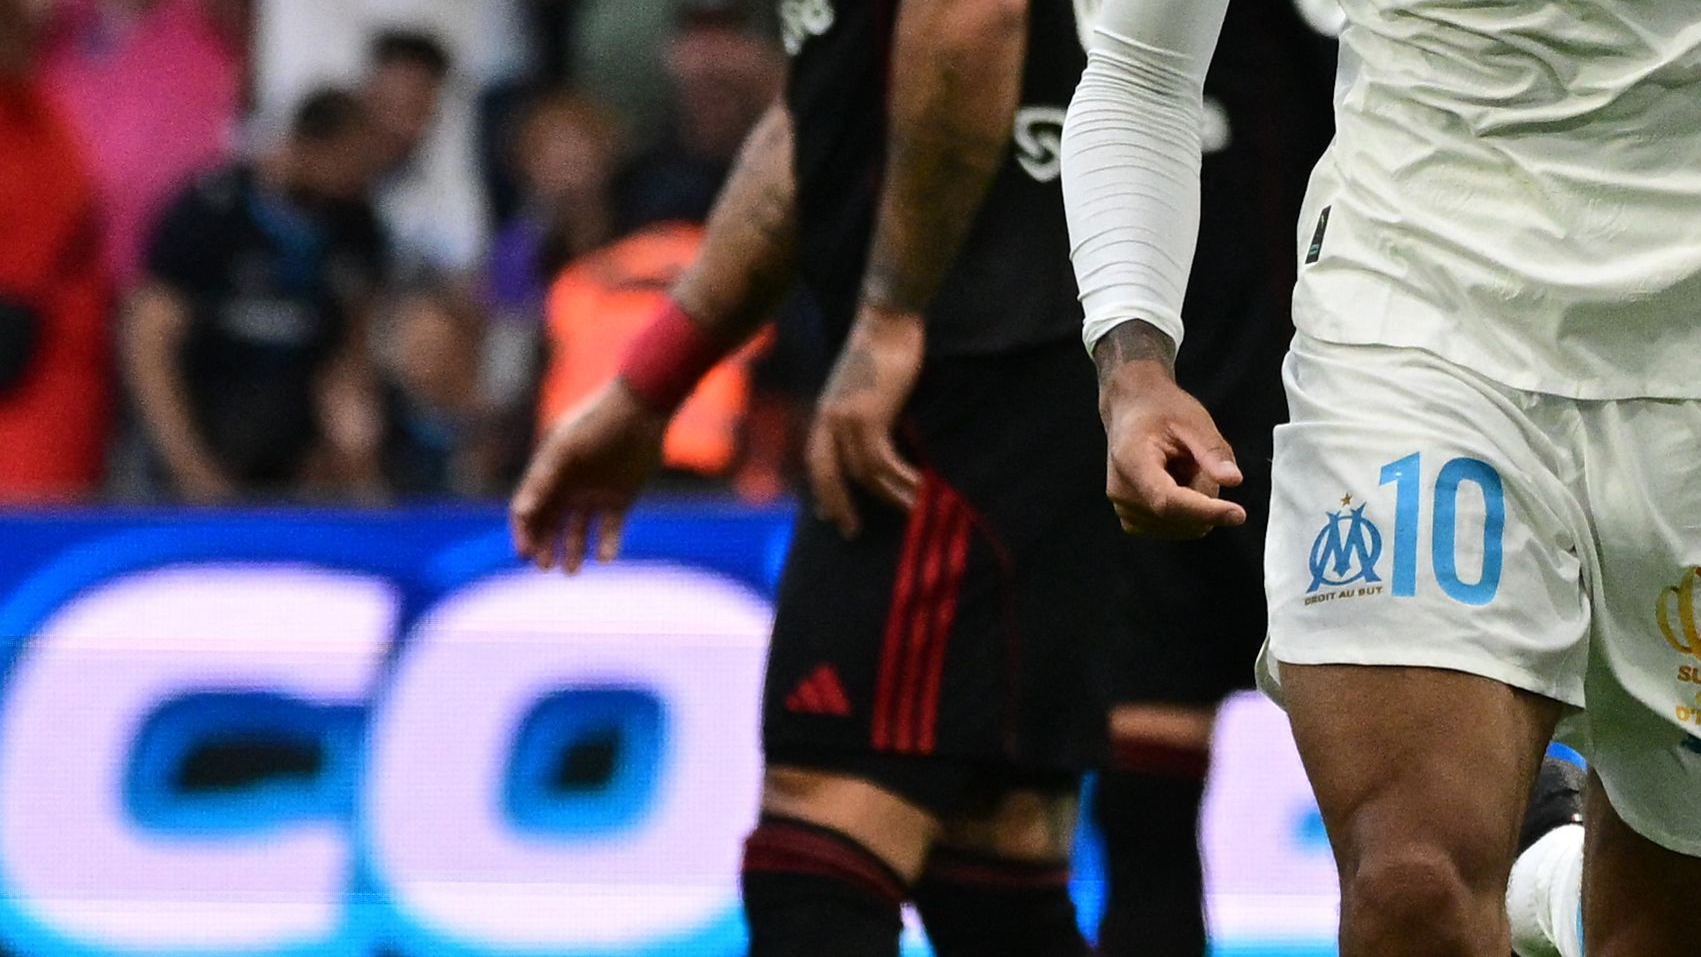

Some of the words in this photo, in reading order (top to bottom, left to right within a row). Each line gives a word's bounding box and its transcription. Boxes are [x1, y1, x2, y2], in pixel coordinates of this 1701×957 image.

[1378, 451, 1506, 607] 10
[1338, 588, 1355, 600] AU
[1358, 585, 1384, 597] BUT
